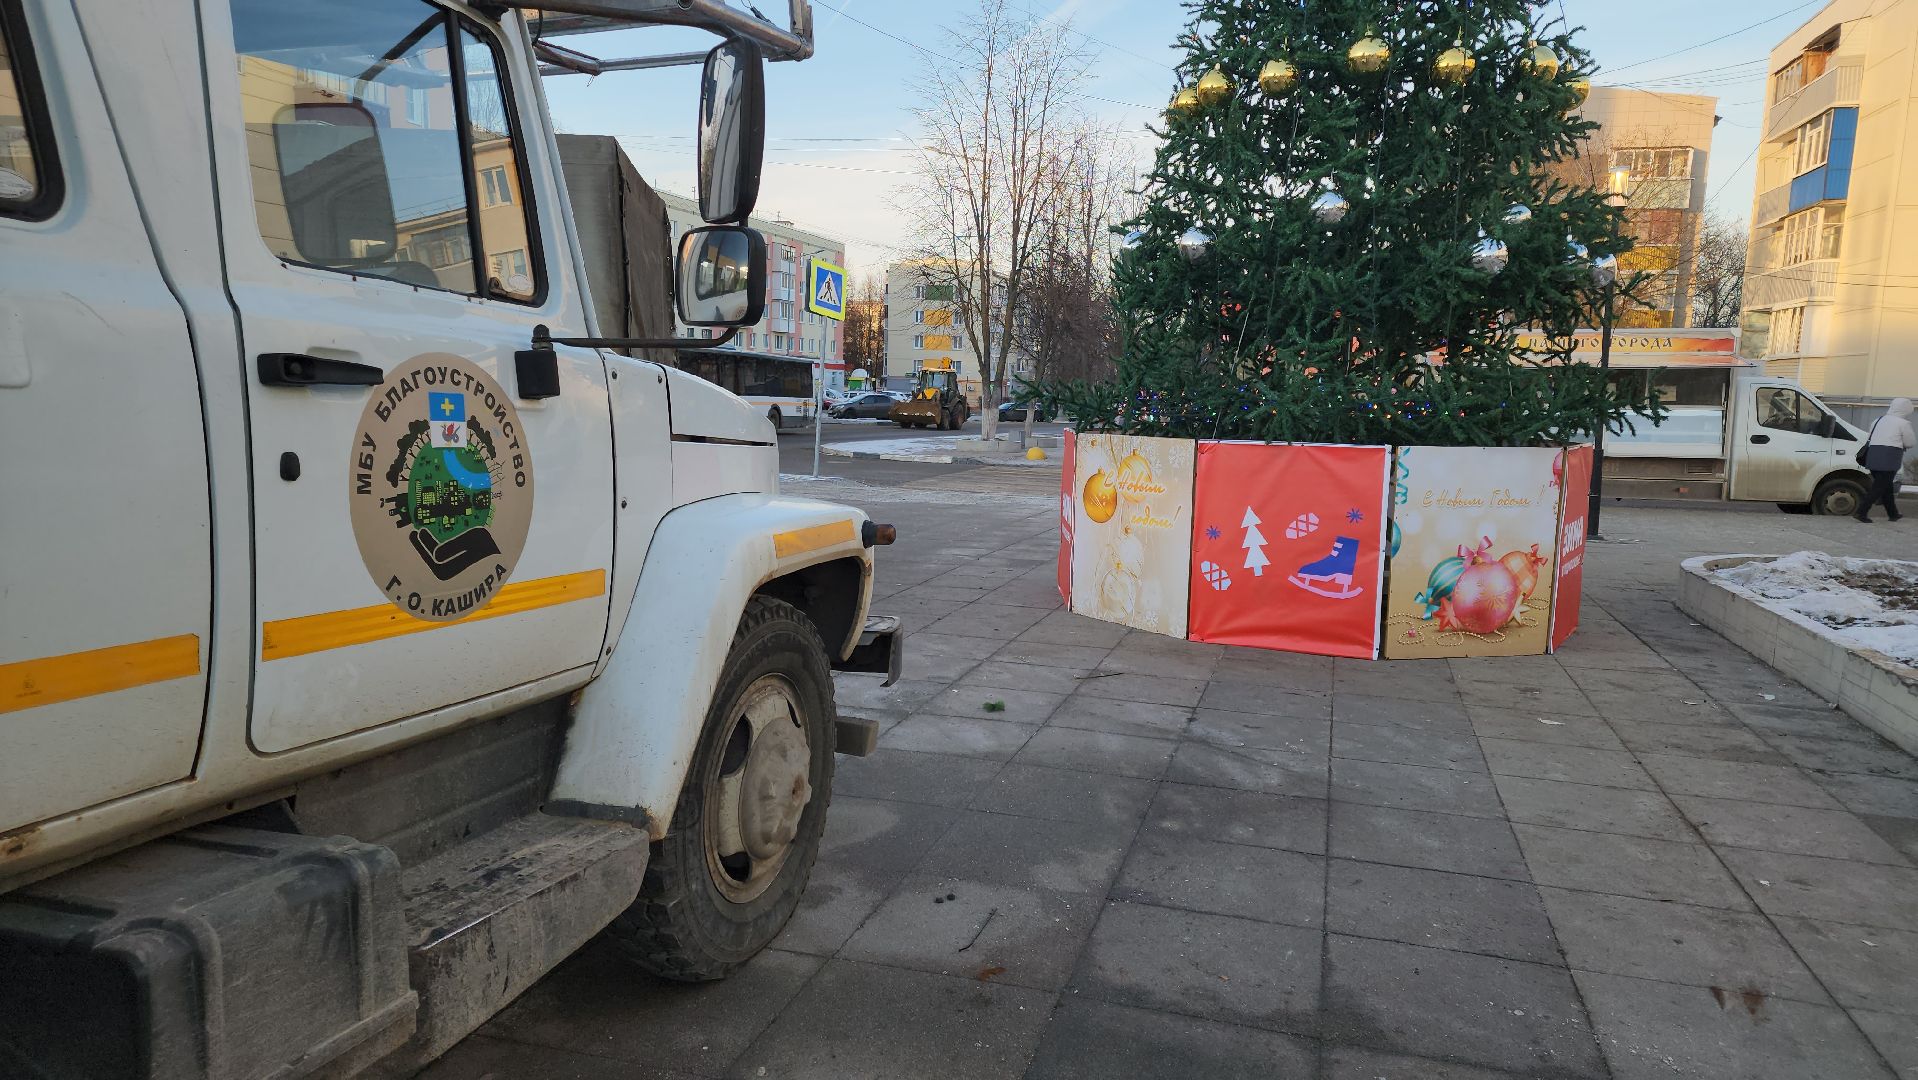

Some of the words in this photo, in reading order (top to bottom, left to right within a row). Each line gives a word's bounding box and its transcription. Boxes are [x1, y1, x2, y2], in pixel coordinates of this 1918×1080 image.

[1528, 337, 1600, 349] НАШГО
[357, 432, 377, 495] МБУ
[374, 366, 526, 488] БЛАГОУСТРОЙСТВО
[1437, 487, 1484, 507] Новым
[385, 574, 402, 601] Г.
[407, 591, 426, 615] О.
[431, 562, 507, 617] КАШИРА
